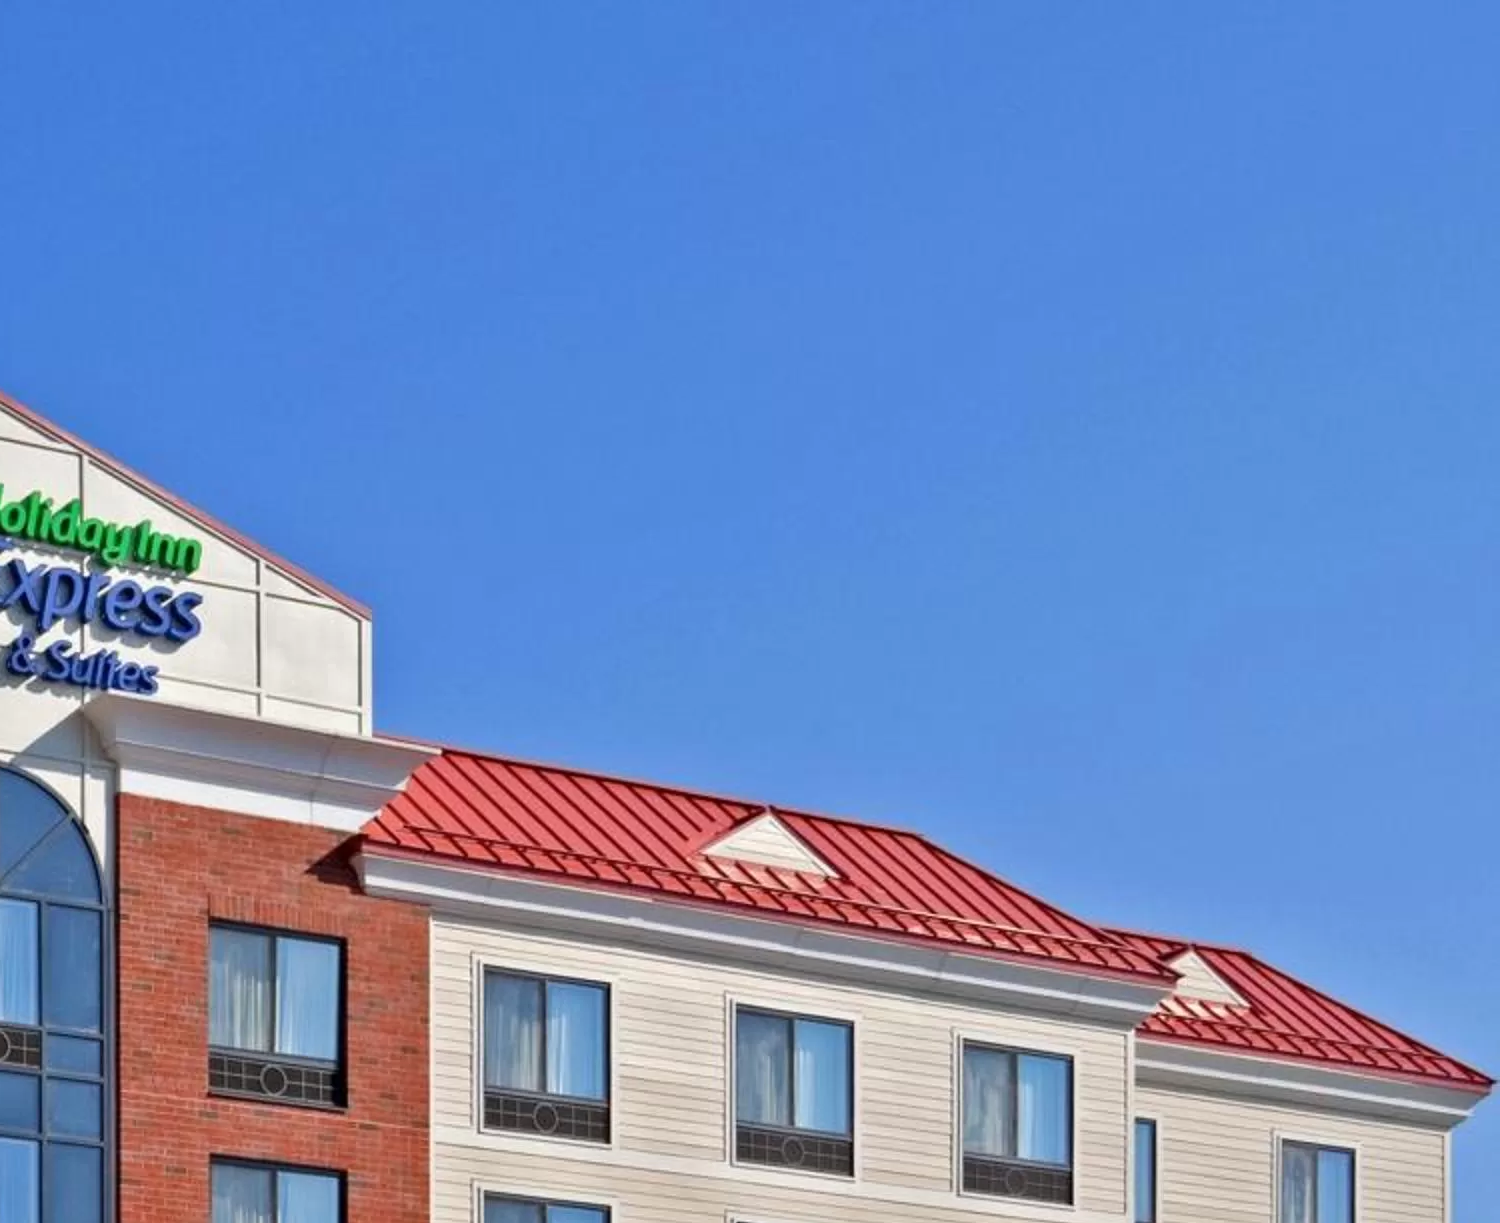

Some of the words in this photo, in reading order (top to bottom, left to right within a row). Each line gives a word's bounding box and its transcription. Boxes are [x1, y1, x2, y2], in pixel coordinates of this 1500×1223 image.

[135, 520, 202, 574] Inn
[7, 633, 38, 674] &
[41, 640, 160, 694] Suites
